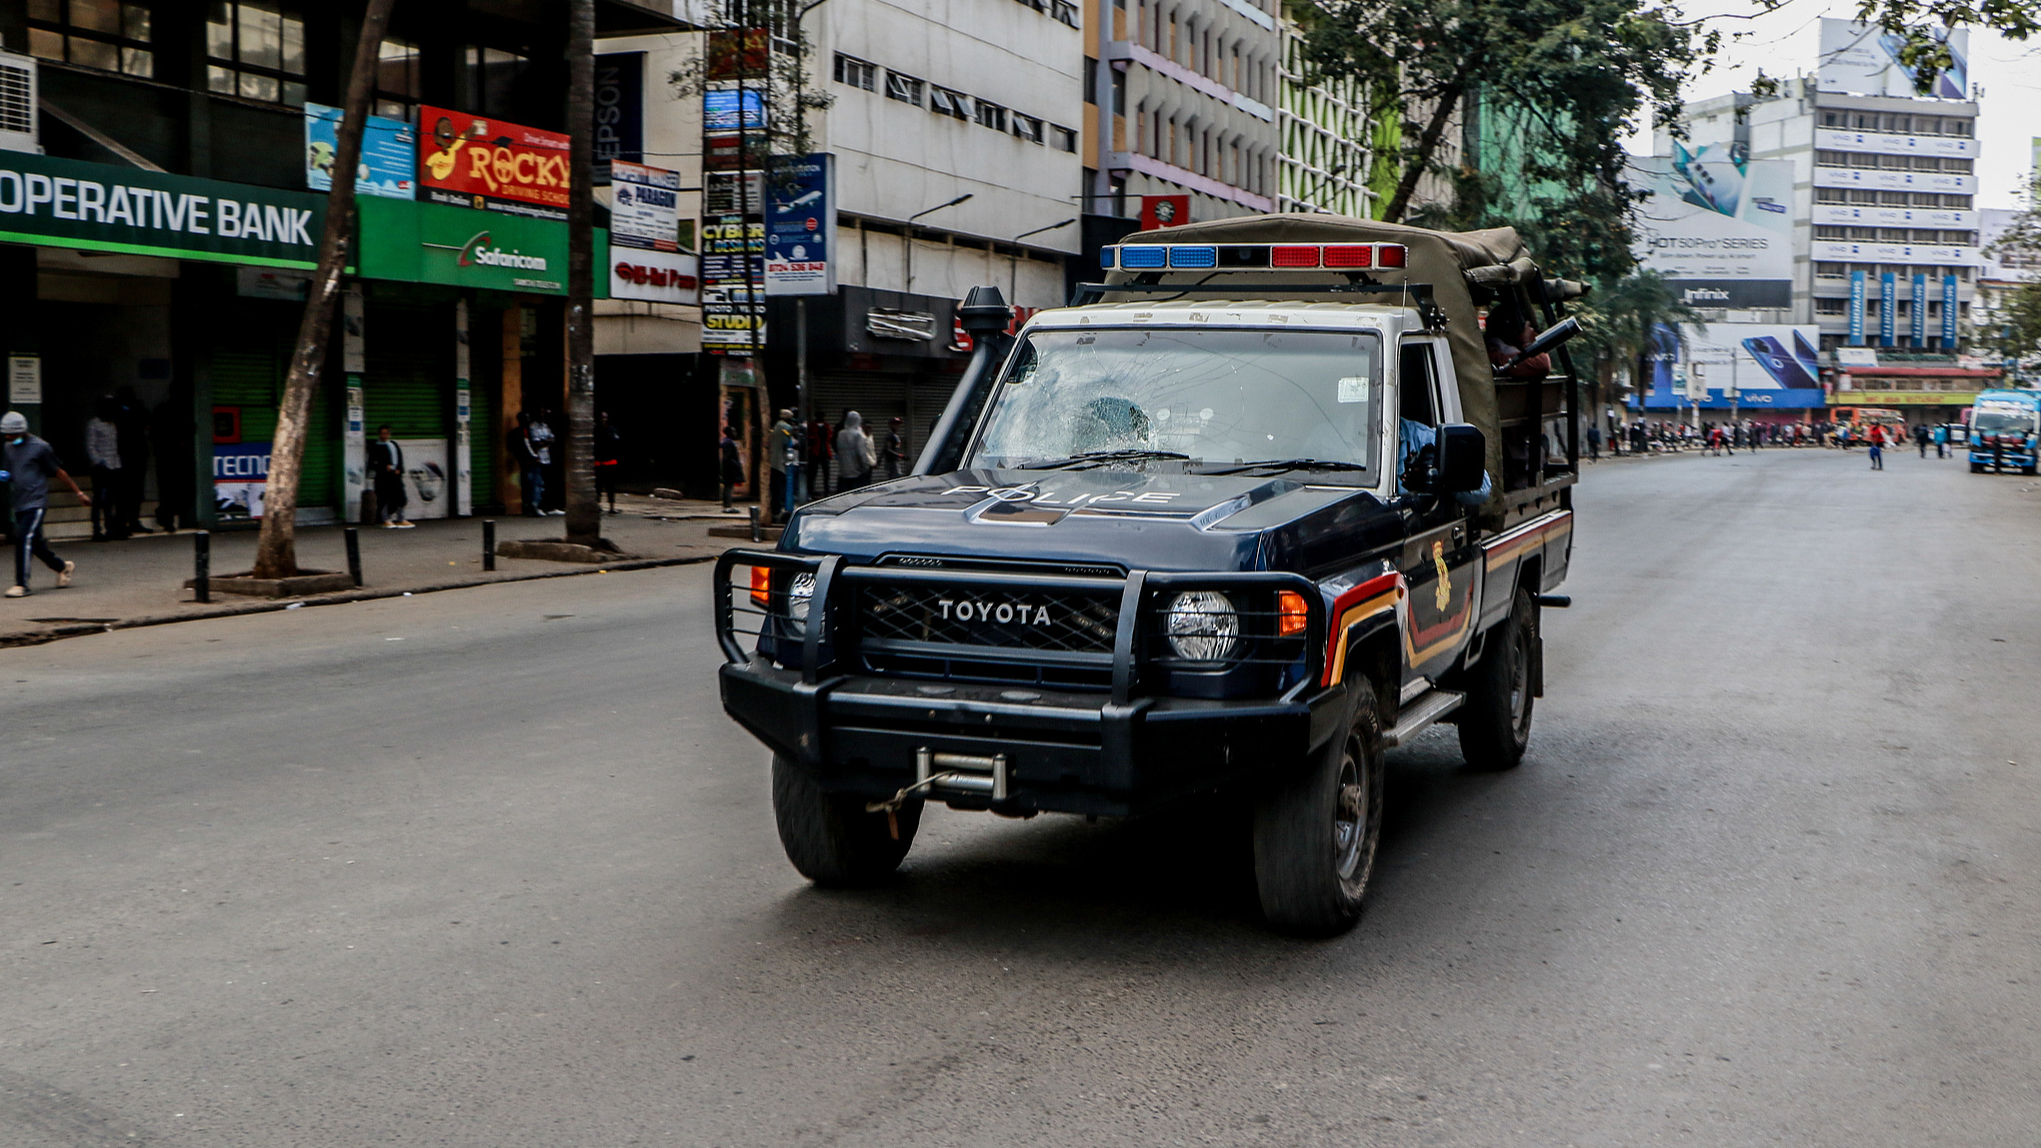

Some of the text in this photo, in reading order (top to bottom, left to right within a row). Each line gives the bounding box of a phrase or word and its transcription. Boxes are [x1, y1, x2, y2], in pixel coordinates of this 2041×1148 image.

[597, 66, 620, 160] EPSON
[0, 169, 314, 247] OPERATIVE BANK
[1722, 238, 1769, 249] SERIES
[475, 246, 546, 271] Safaricom
[941, 484, 1180, 505] POLICE
[938, 599, 1051, 626] TOYOTA
